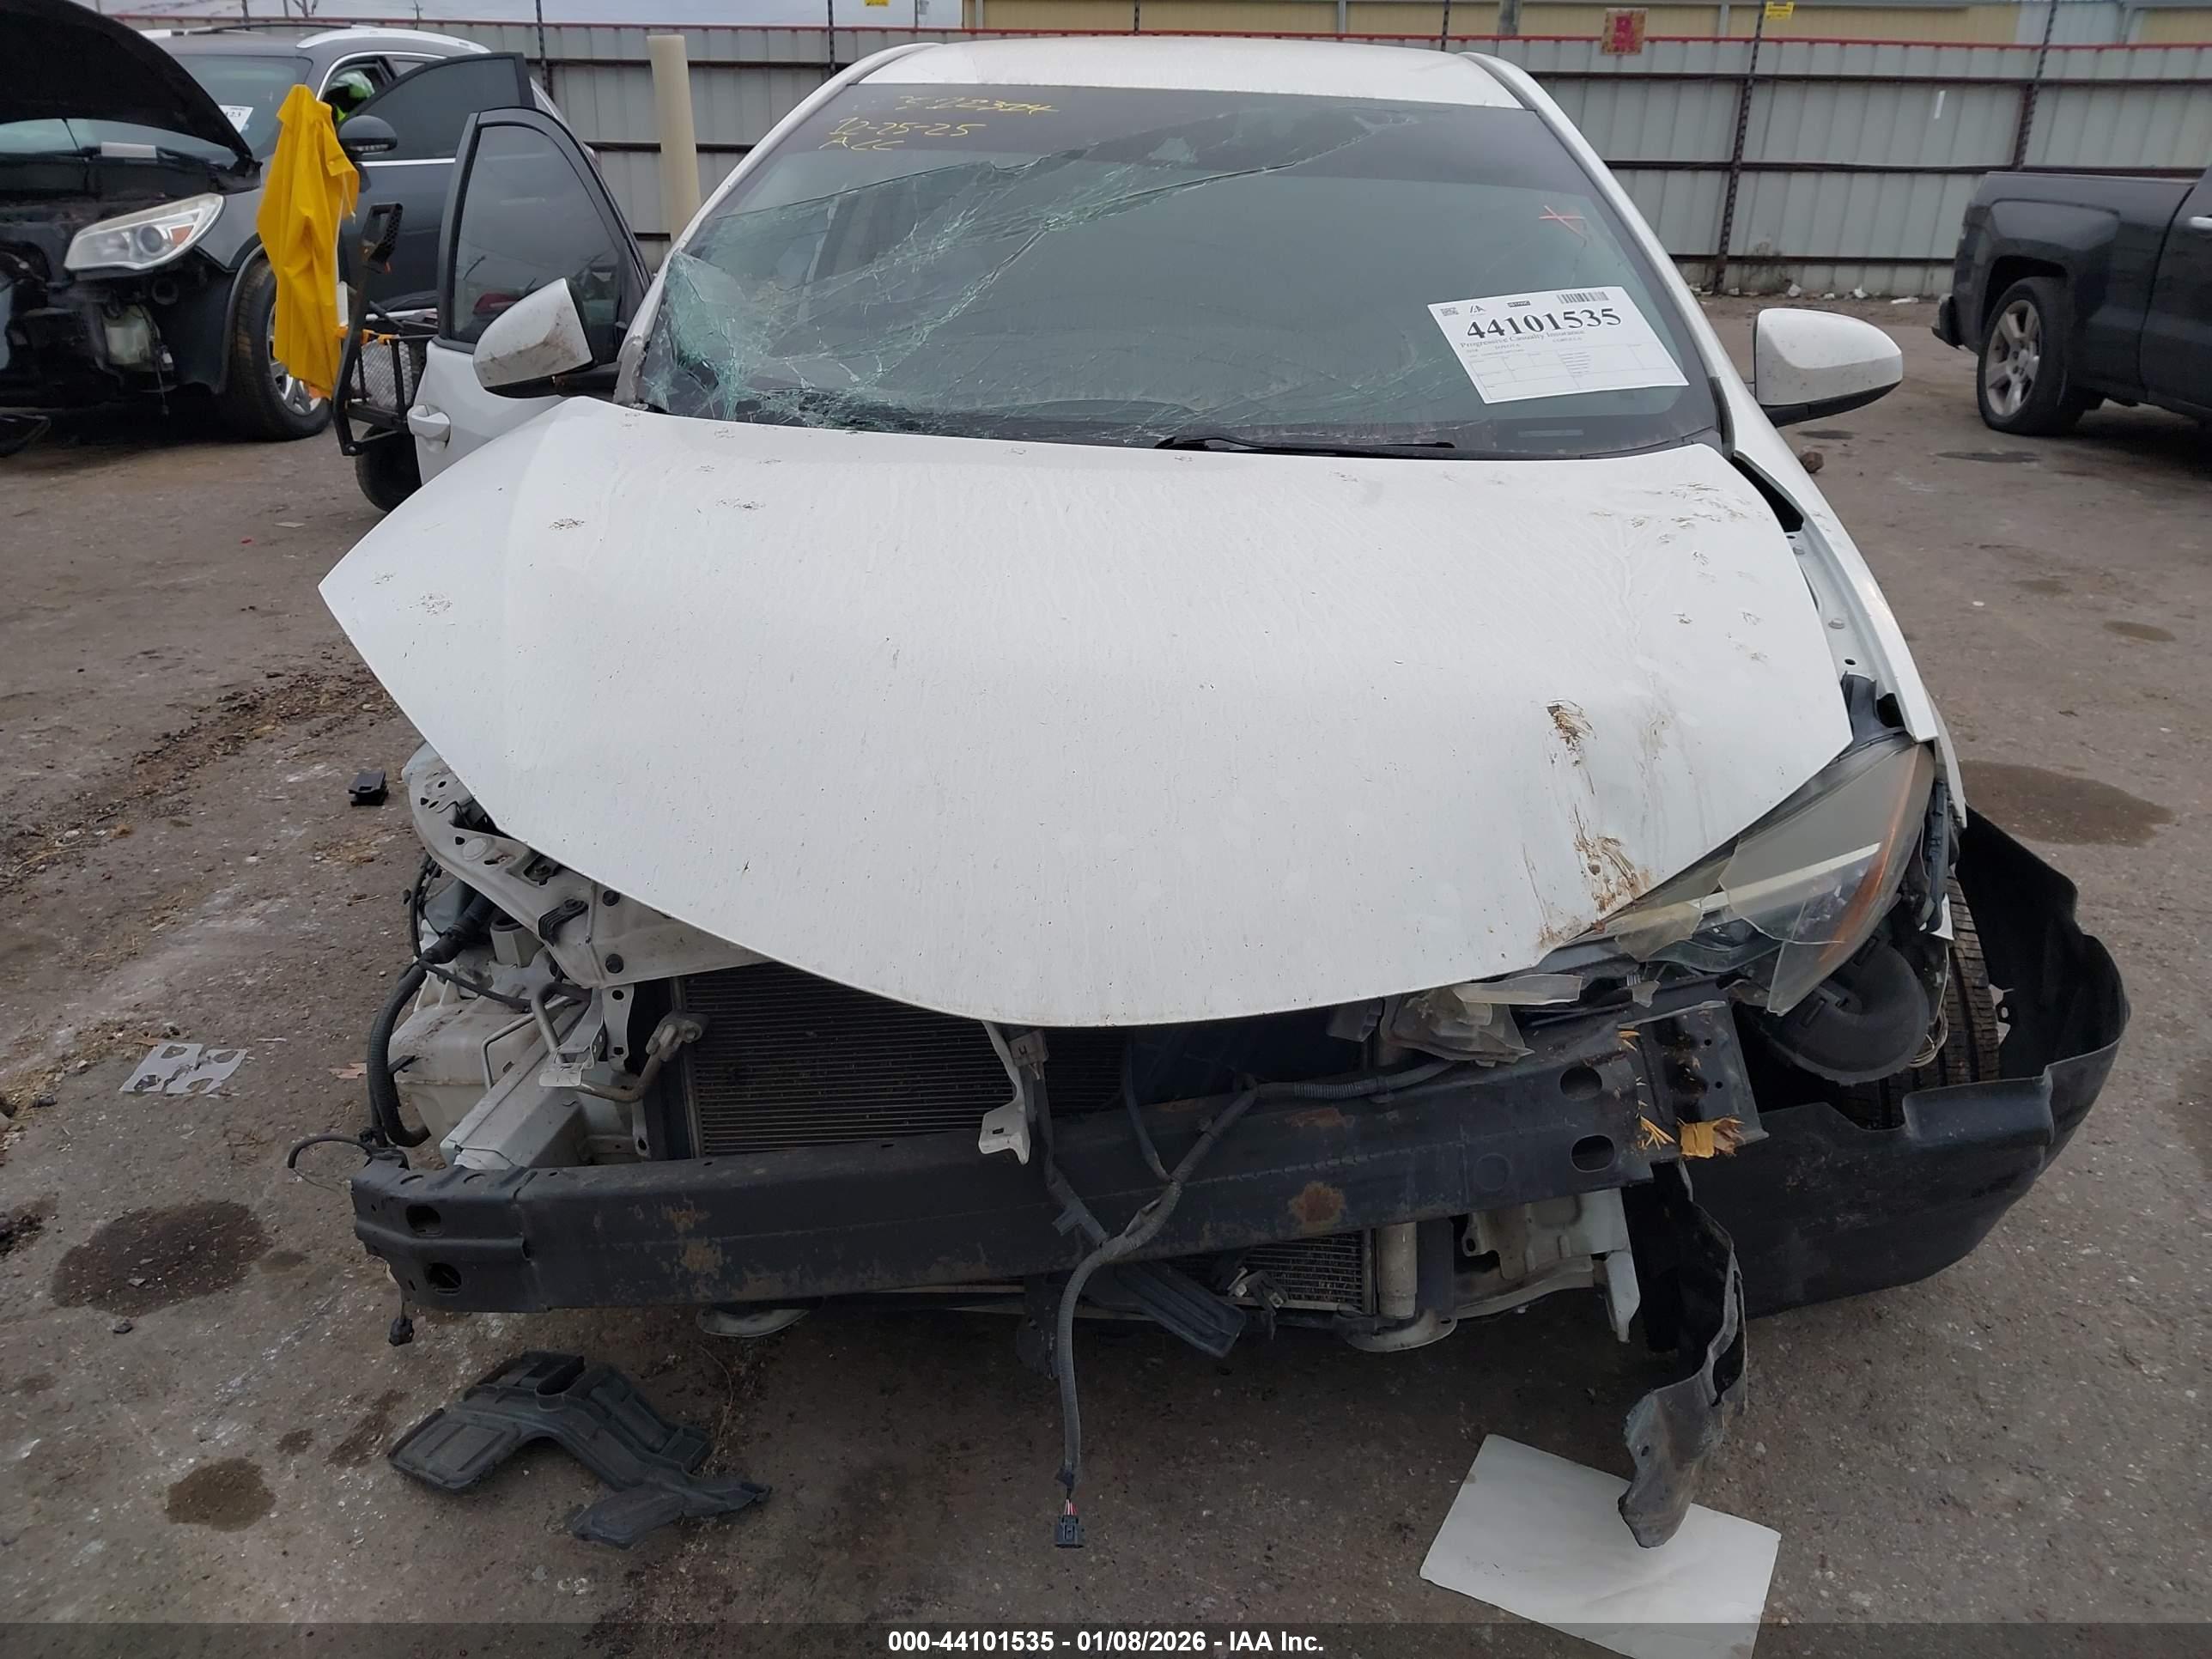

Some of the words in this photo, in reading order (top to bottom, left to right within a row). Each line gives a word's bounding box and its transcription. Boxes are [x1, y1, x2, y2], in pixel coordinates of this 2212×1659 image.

[1467, 307, 1623, 339] 44101535
[1460, 337, 1509, 348] Progressive
[1509, 332, 1544, 343] Casualty
